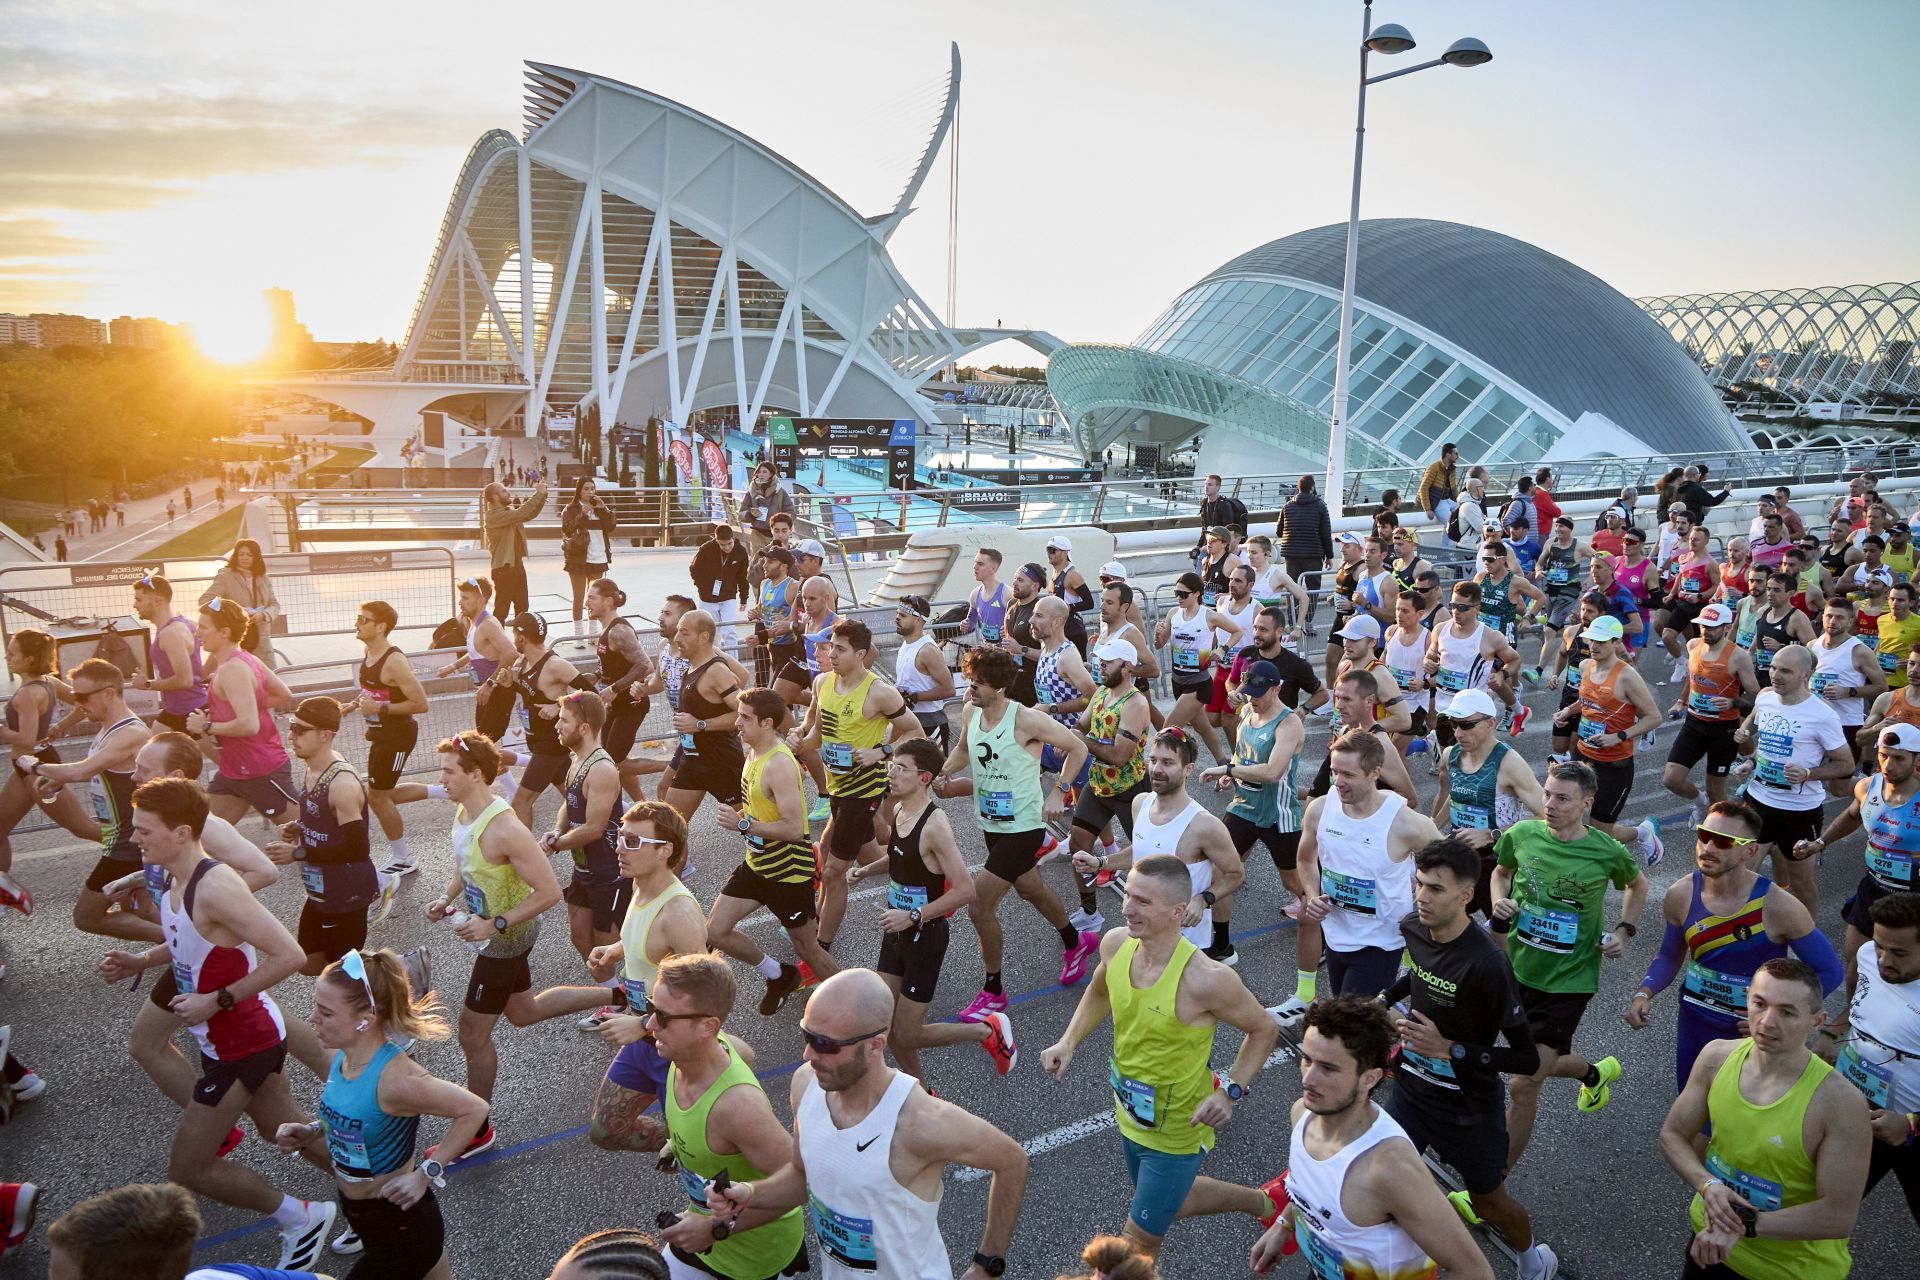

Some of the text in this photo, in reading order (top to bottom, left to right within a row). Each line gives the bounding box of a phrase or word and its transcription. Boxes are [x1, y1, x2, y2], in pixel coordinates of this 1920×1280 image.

[961, 492, 1007, 503] ¡BRAVO!
[1334, 882, 1359, 896] 33215
[1335, 892, 1358, 904] Anders
[1530, 917, 1559, 932] 33416
[1530, 926, 1558, 940] Marinus
[1418, 966, 1457, 992] balance
[1701, 978, 1732, 994] 33688
[842, 1219, 862, 1229] ZURICH
